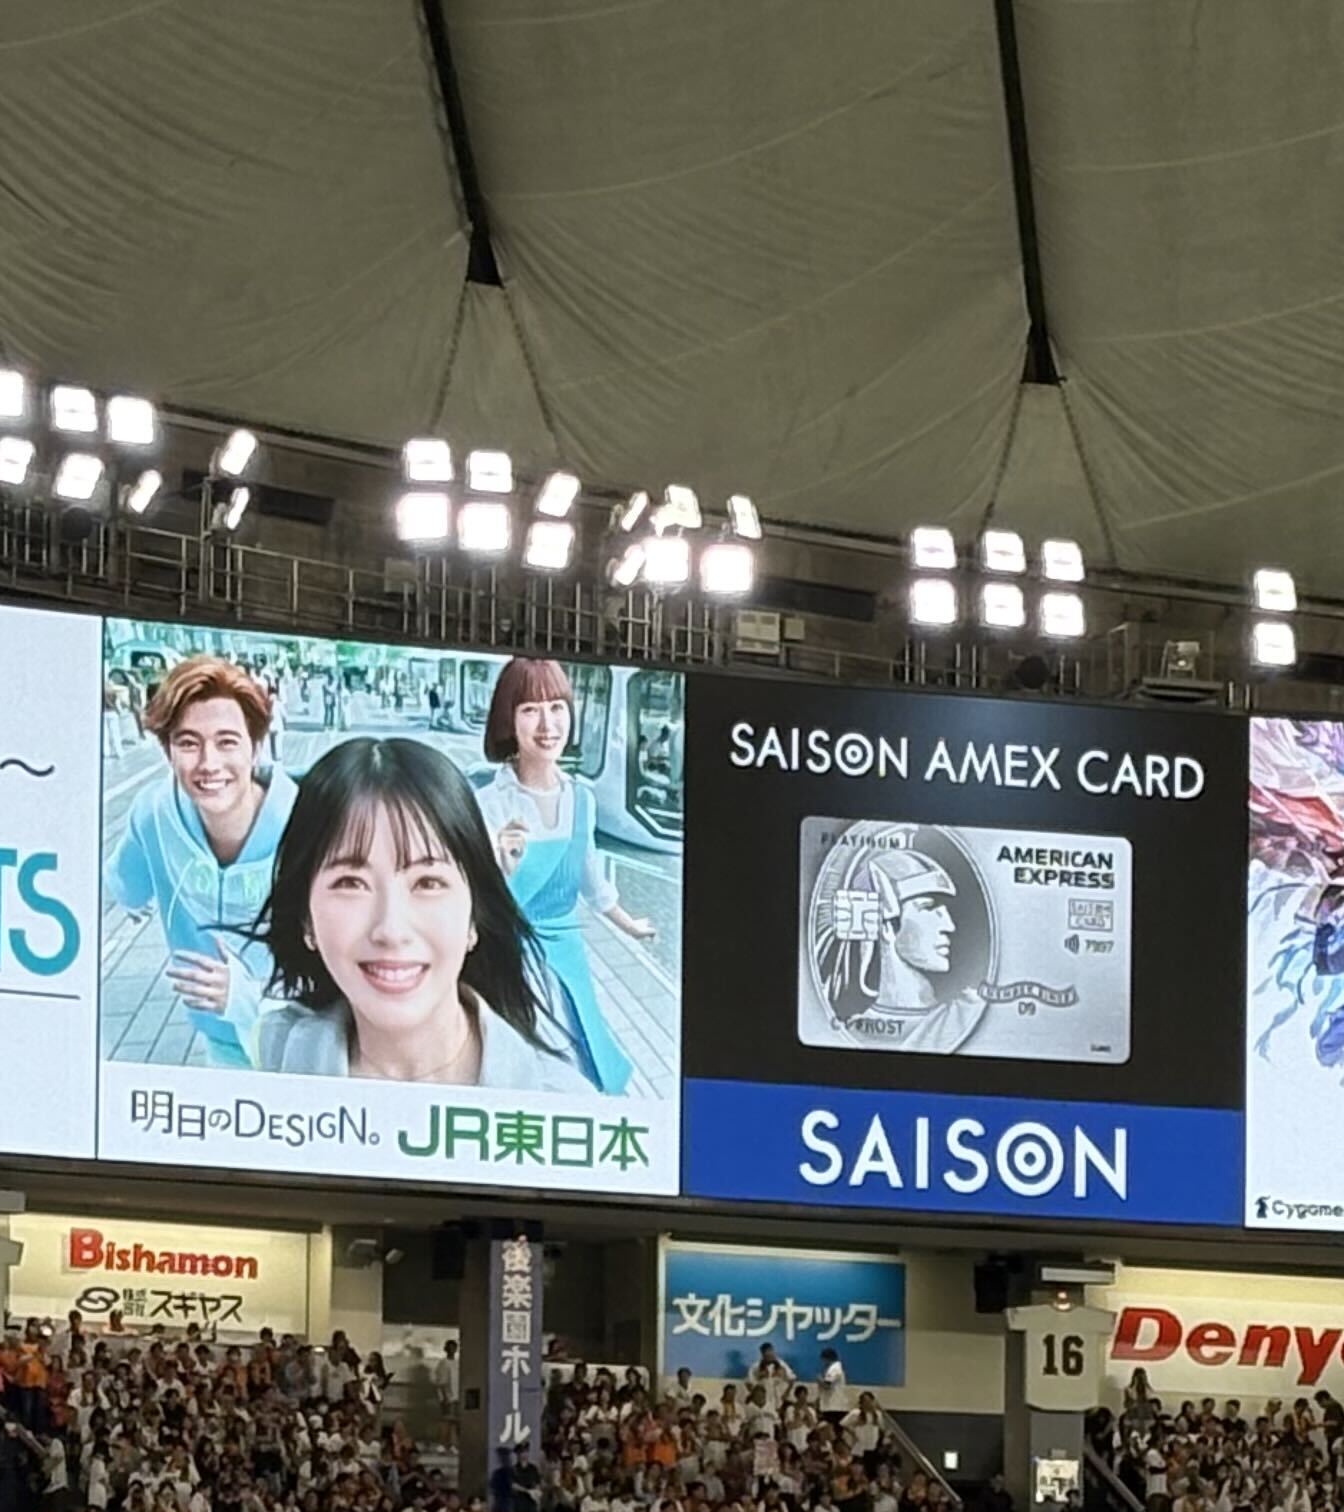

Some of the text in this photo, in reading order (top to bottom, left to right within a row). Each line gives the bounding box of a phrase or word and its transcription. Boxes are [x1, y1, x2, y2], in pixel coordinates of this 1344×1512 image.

[729, 722, 1205, 800] SAISON AMEX CARD
[996, 845, 1114, 869] AMERICAN
[1013, 866, 1115, 889] EXPRESS
[397, 1104, 650, 1171] JR東日本
[799, 1108, 1128, 1201] SAISON
[69, 1228, 258, 1280] Bishamon
[150, 1290, 244, 1323] スギヤス
[499, 1237, 534, 1445] 後楽園ホール
[1042, 1333, 1085, 1377] 16
